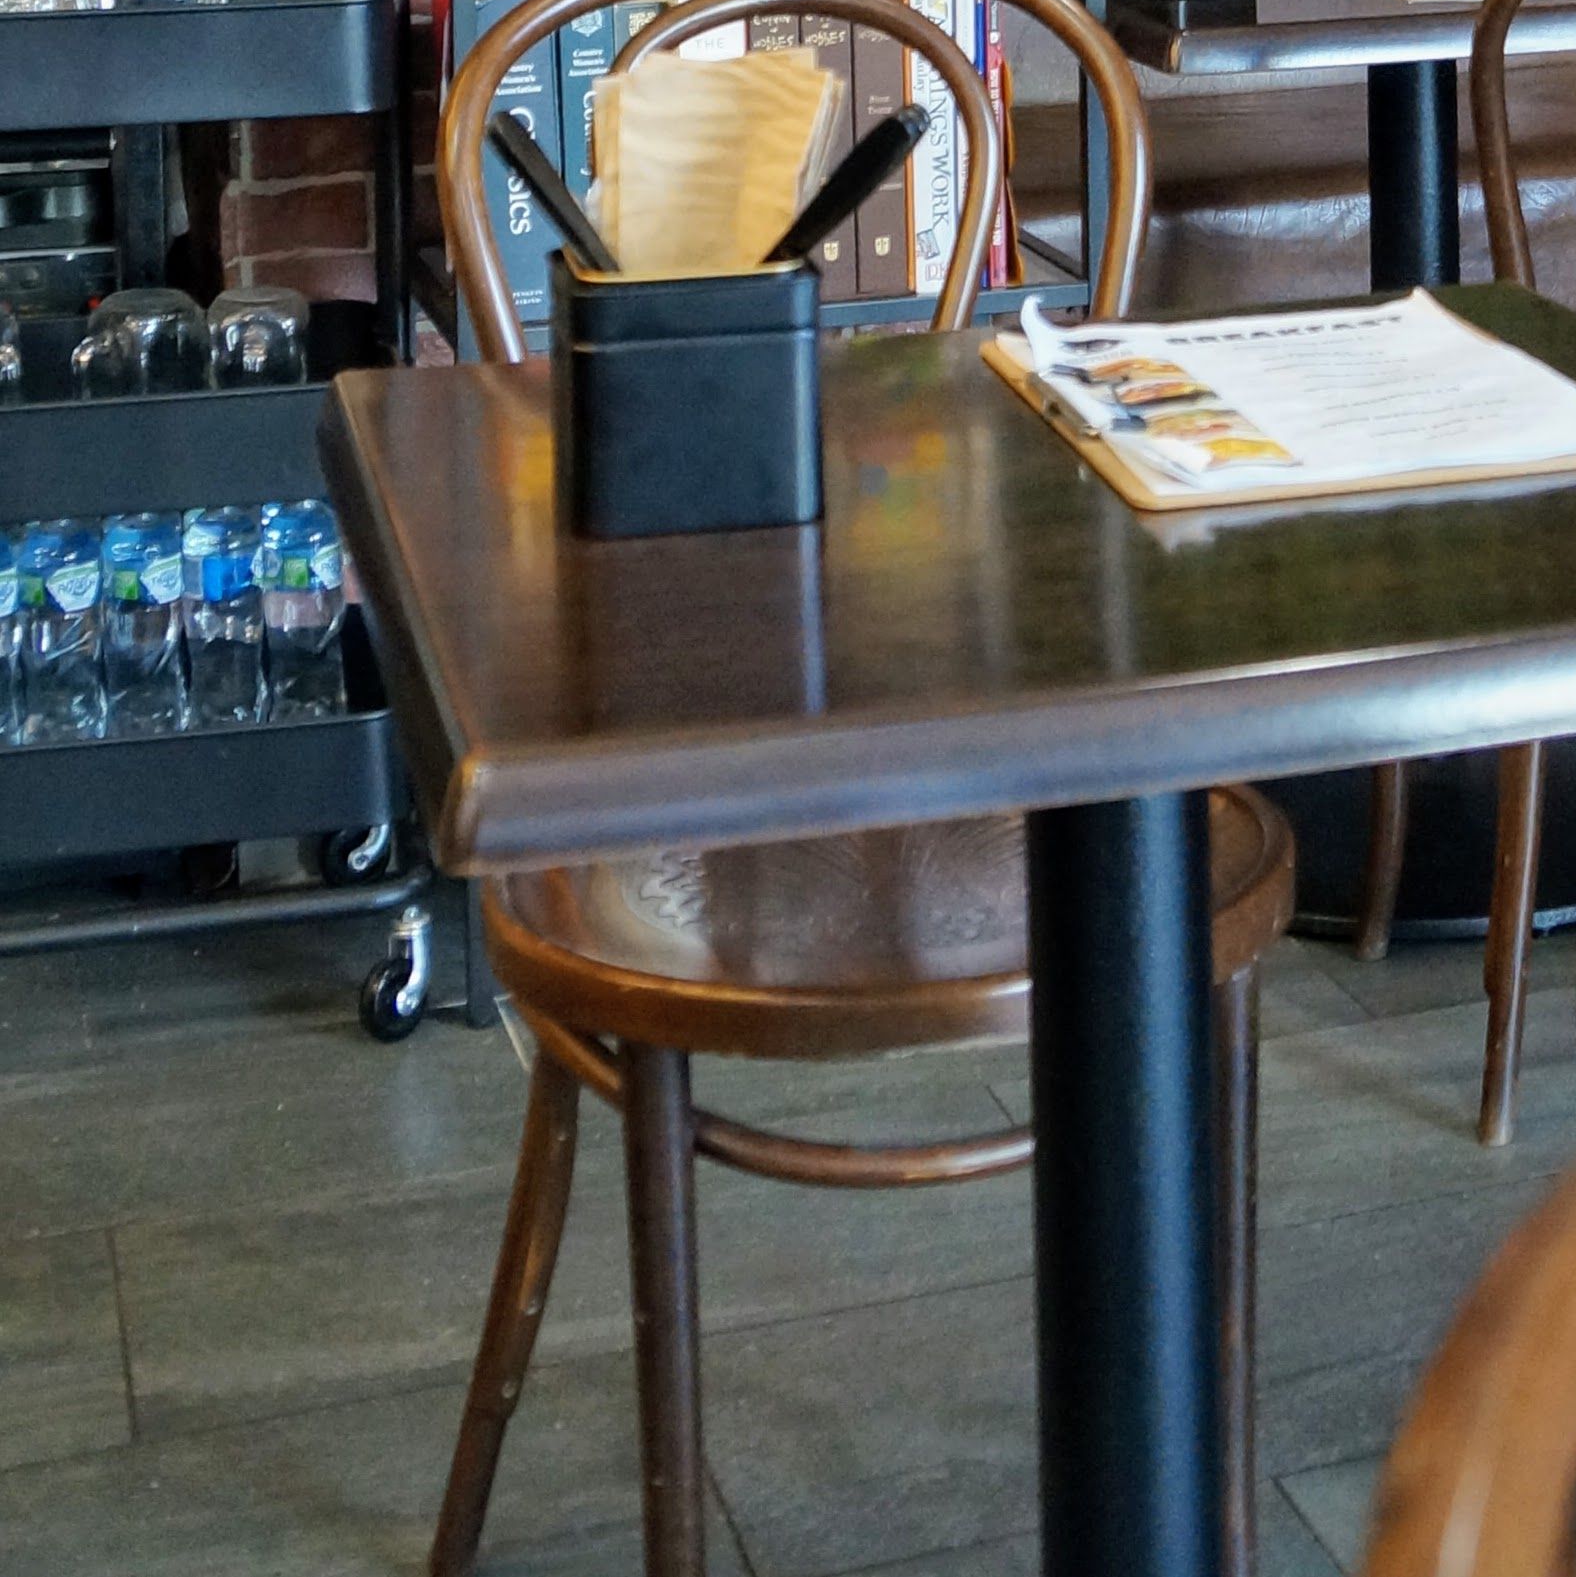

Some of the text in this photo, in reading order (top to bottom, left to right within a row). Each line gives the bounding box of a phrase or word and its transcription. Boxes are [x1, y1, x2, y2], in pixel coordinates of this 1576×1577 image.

[696, 37, 726, 49] THE
[932, 149, 953, 229] WORK
[1164, 316, 1402, 344] BREAKFAST
